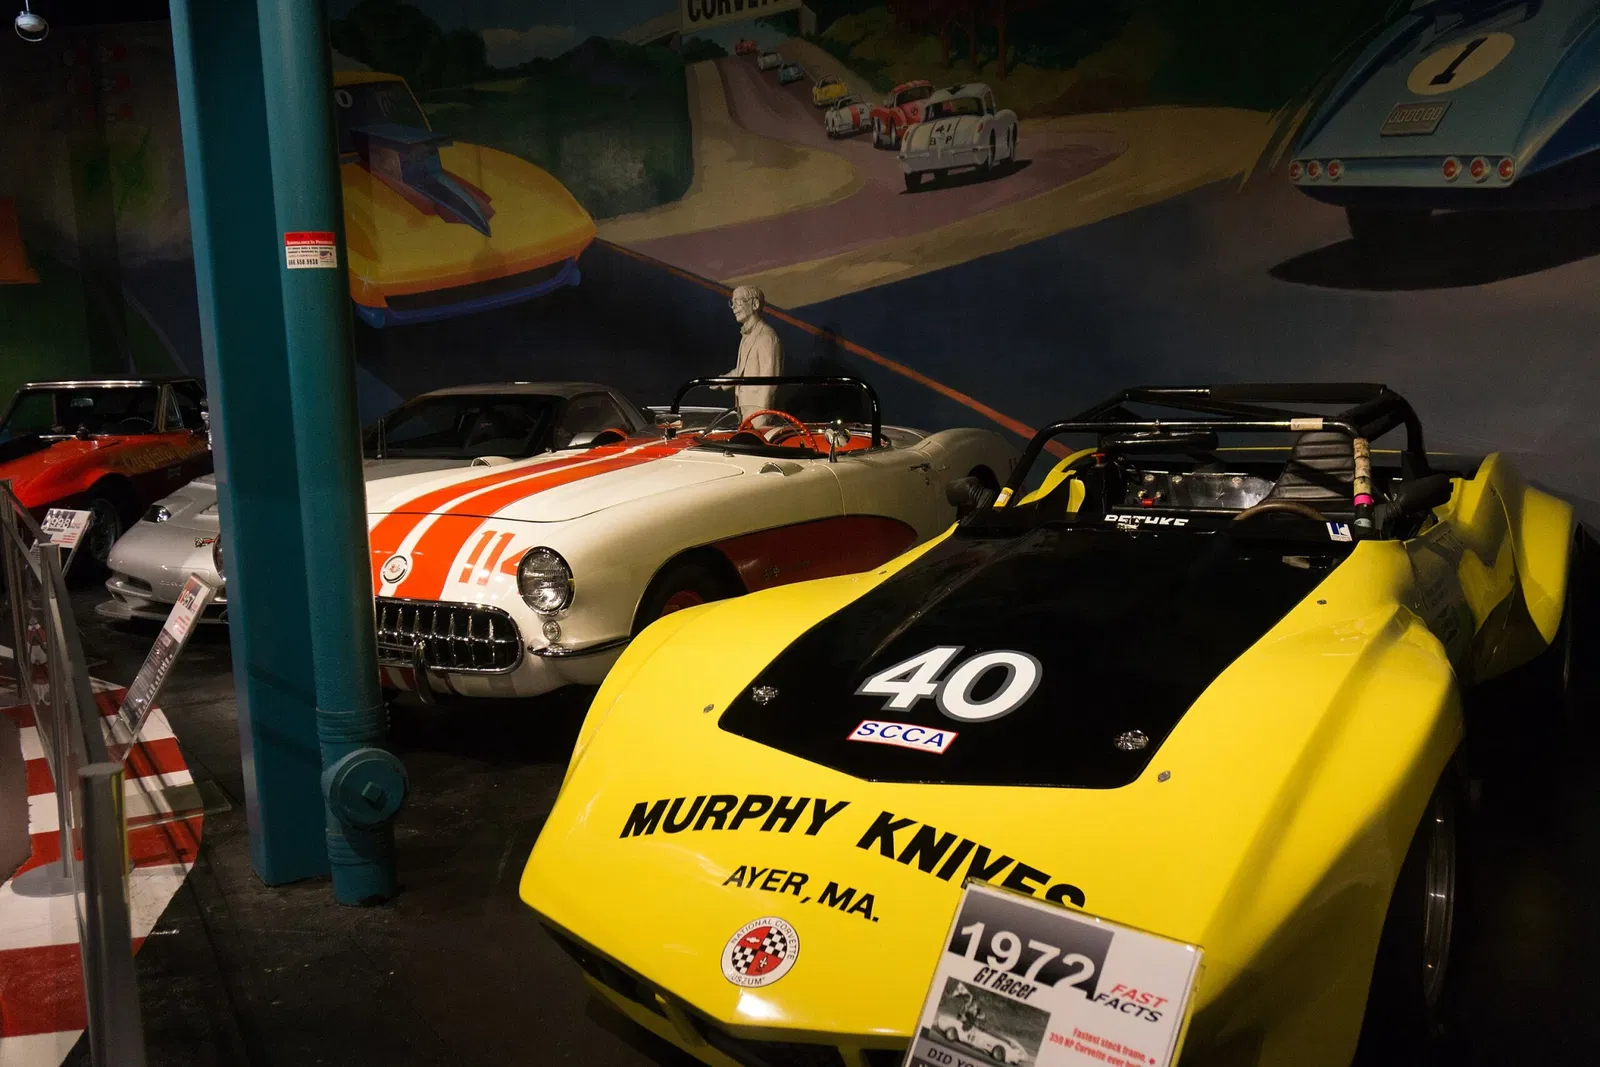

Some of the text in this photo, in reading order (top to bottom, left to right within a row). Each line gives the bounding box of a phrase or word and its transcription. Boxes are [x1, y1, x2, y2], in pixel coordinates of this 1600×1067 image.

[1429, 37, 1488, 86] 1
[936, 122, 952, 133] 41
[853, 645, 1044, 723] 40
[857, 723, 945, 747] SCCA
[619, 794, 1087, 909] MURPHY KNIVES
[723, 865, 880, 923] AYER, MA.
[731, 919, 797, 960] NATIONAL CORVETTE
[961, 921, 1096, 1000] 1972
[973, 967, 1038, 1000] GT Racer
[1110, 984, 1168, 1009] FAST
[1094, 993, 1163, 1023] FACTS
[927, 1048, 953, 1065] DID
